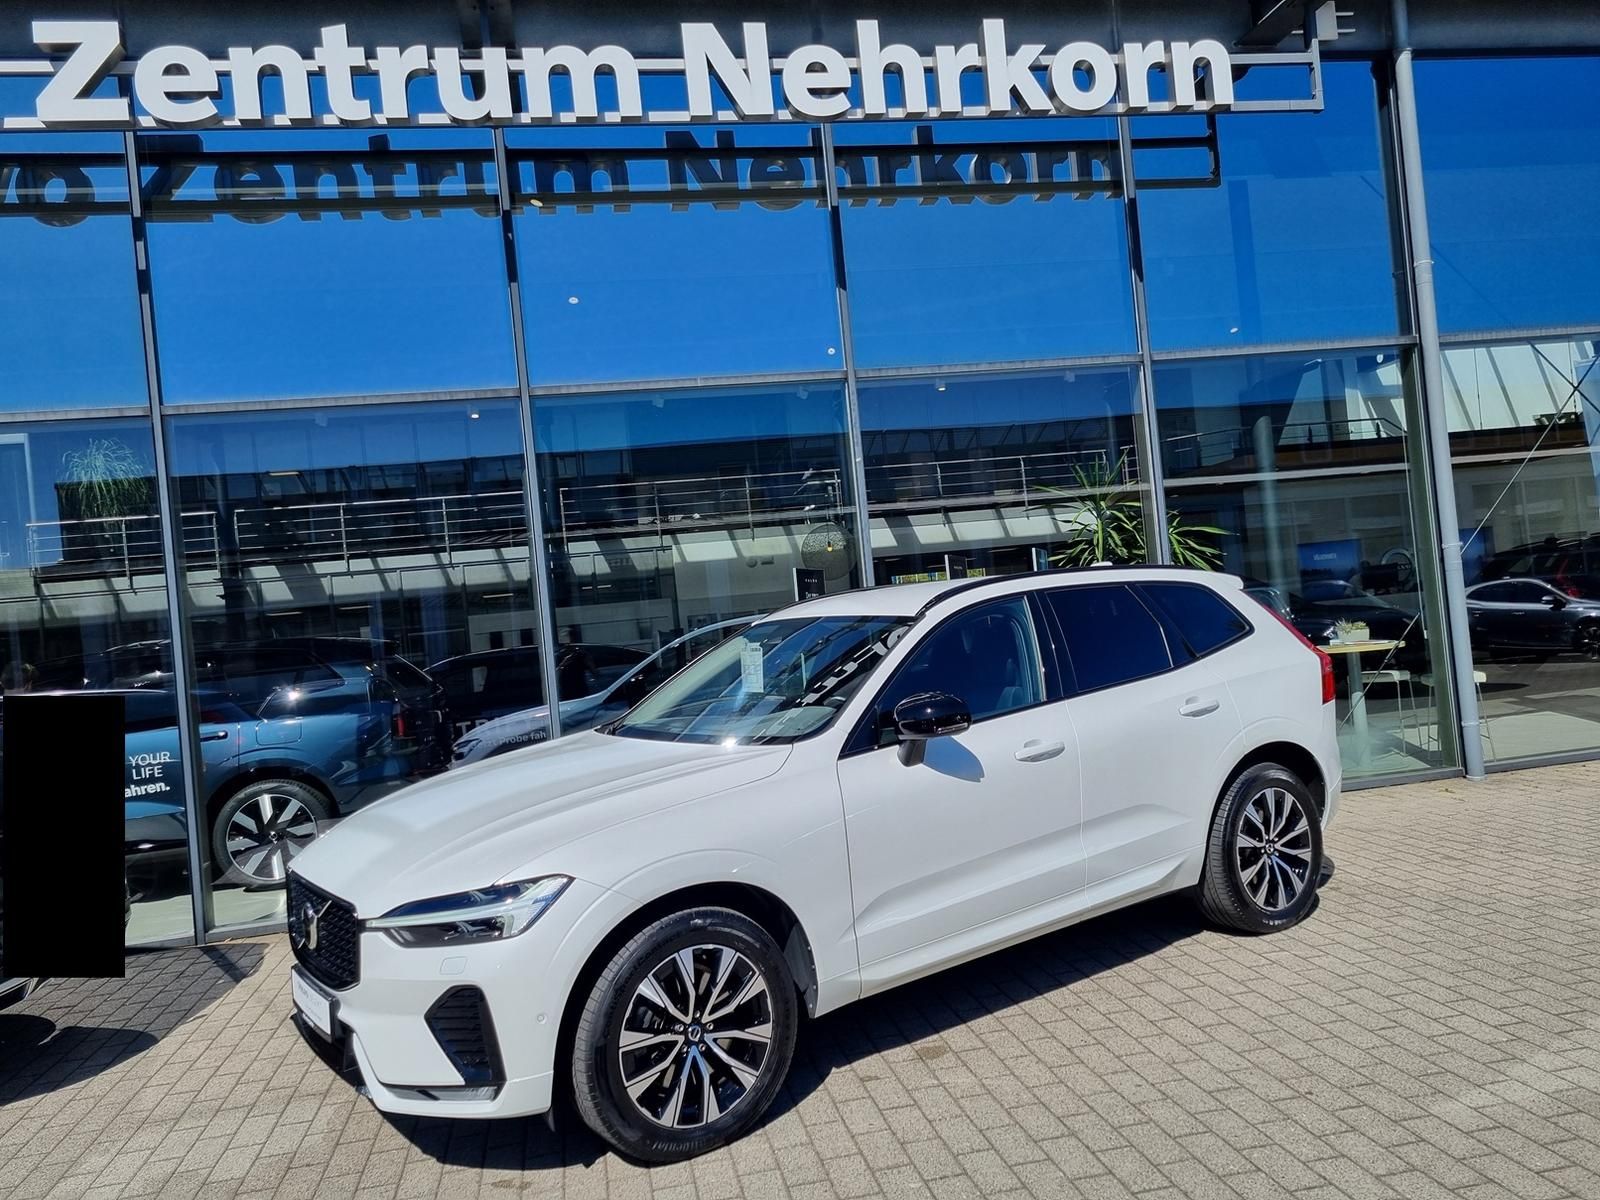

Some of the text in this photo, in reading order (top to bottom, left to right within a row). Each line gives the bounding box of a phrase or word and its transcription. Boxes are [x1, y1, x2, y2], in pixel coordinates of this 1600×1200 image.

[32, 18, 1235, 125] Zentrum Nehrkorn
[530, 731, 546, 741] fah
[128, 751, 170, 767] YOUR
[132, 765, 163, 780] LIFE
[125, 782, 170, 798] ahren.
